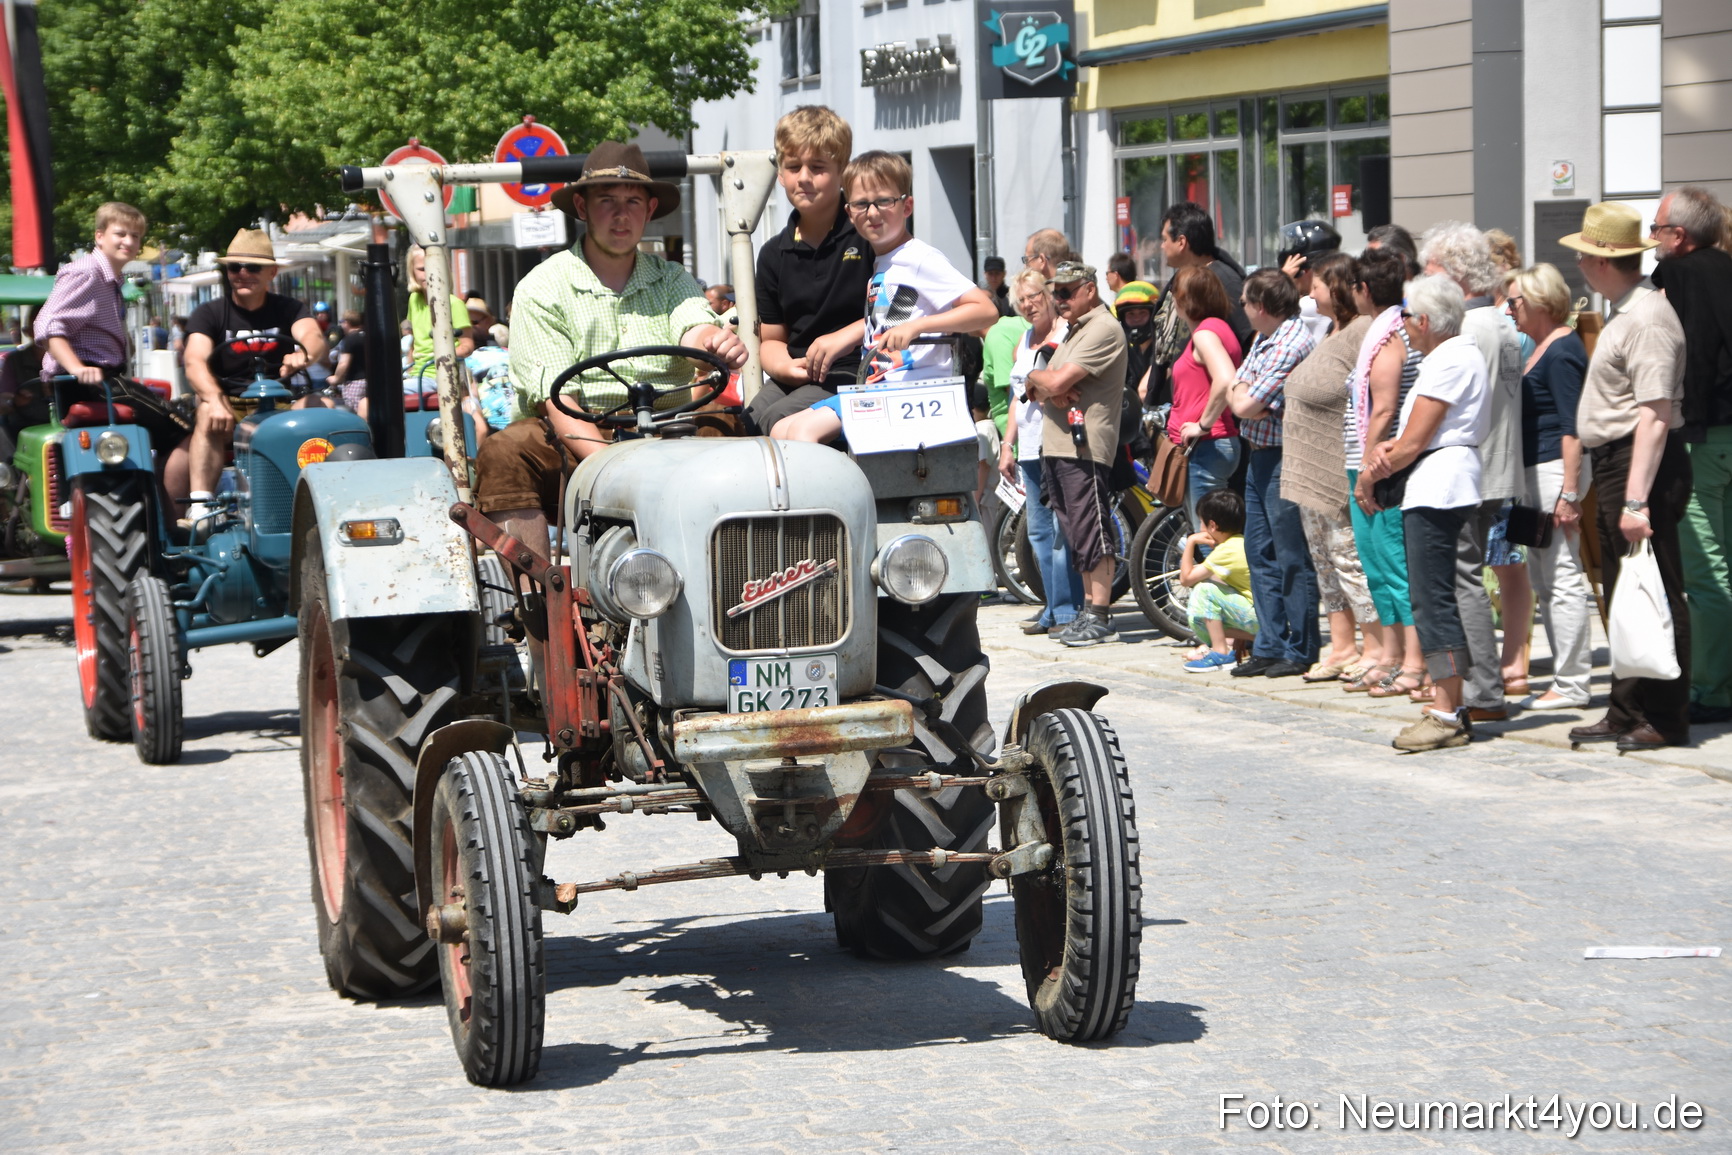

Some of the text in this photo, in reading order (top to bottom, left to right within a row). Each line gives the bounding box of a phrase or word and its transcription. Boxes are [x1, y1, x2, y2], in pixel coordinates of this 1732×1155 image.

[1015, 25, 1047, 68] G2
[900, 400, 943, 420] 212
[742, 559, 816, 603] Eicher
[756, 661, 791, 687] NM
[737, 685, 829, 713] GK 273
